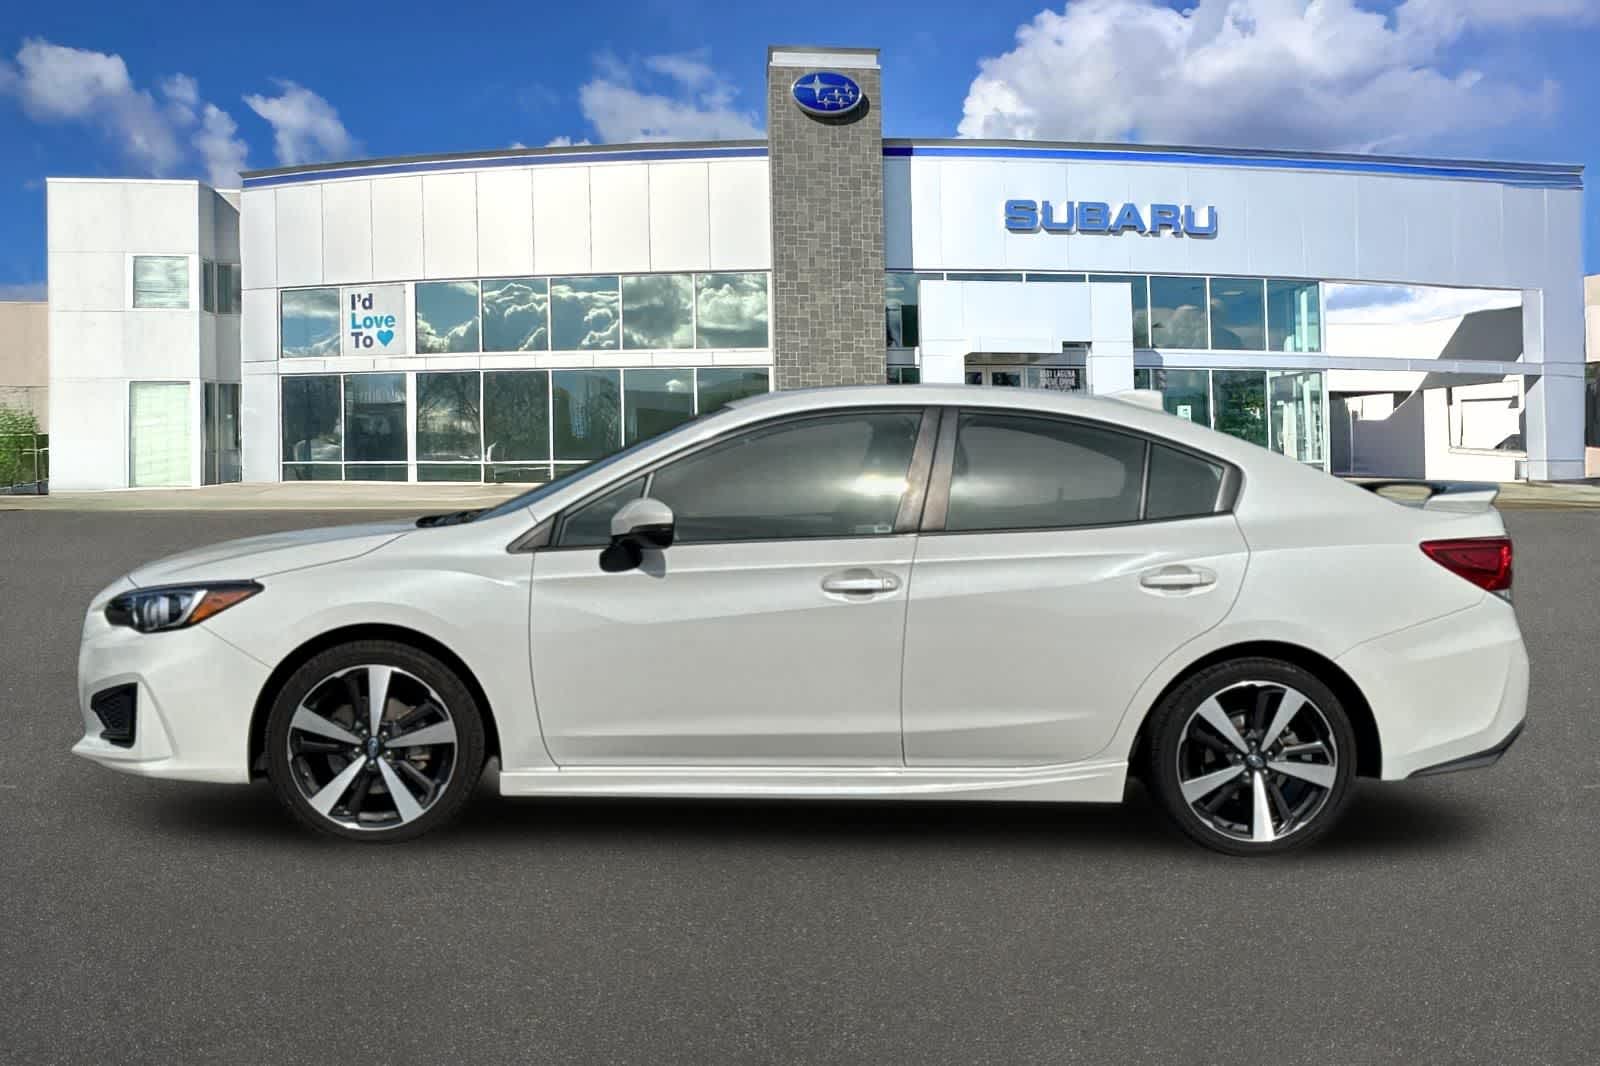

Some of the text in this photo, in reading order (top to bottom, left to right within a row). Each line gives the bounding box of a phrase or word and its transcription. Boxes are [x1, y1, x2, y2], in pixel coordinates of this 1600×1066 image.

[1005, 199, 1218, 239] SUBARU
[351, 293, 373, 310] I’d
[351, 312, 396, 329] Love
[351, 331, 374, 348] To
